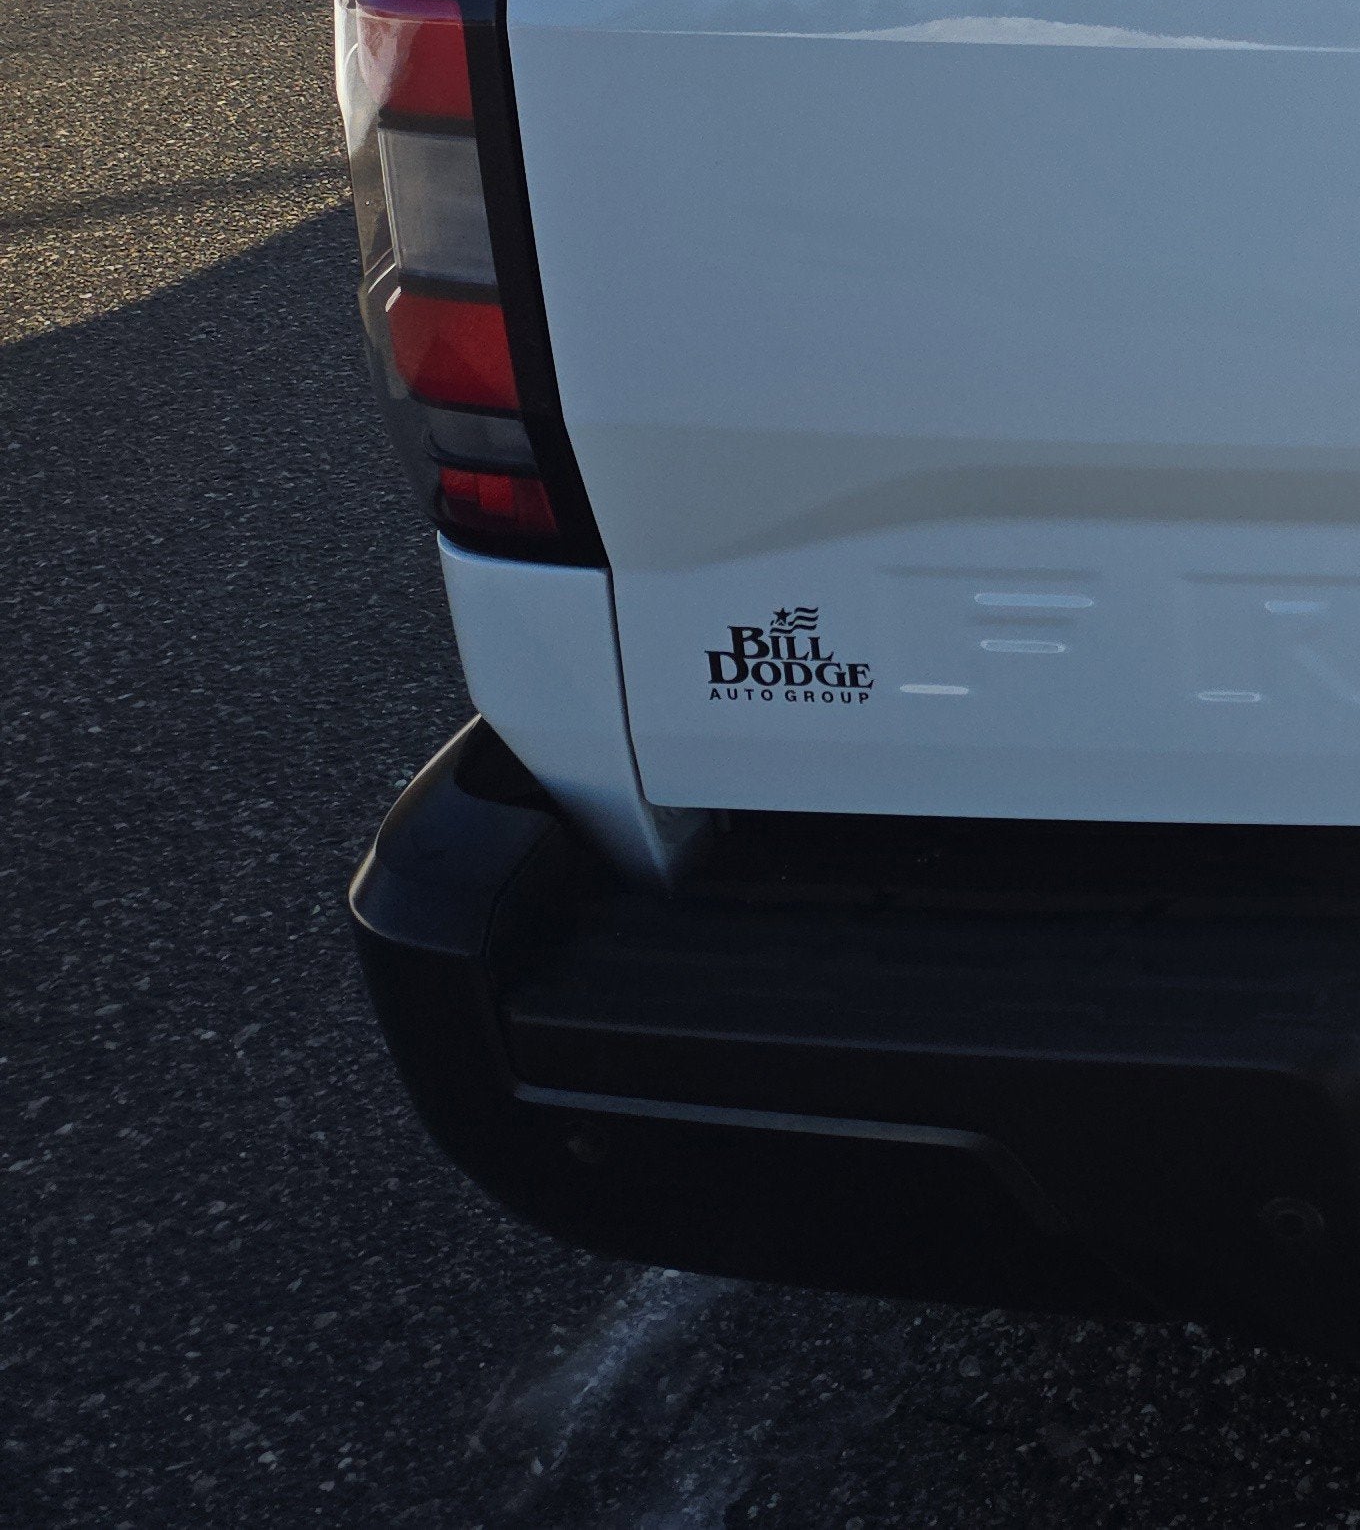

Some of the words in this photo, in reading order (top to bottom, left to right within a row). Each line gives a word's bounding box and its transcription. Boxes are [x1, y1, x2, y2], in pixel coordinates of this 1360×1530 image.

[727, 625, 834, 662] BILL
[705, 650, 874, 689] DODGE
[709, 687, 774, 702] AUTO
[784, 689, 869, 704] GROUP
